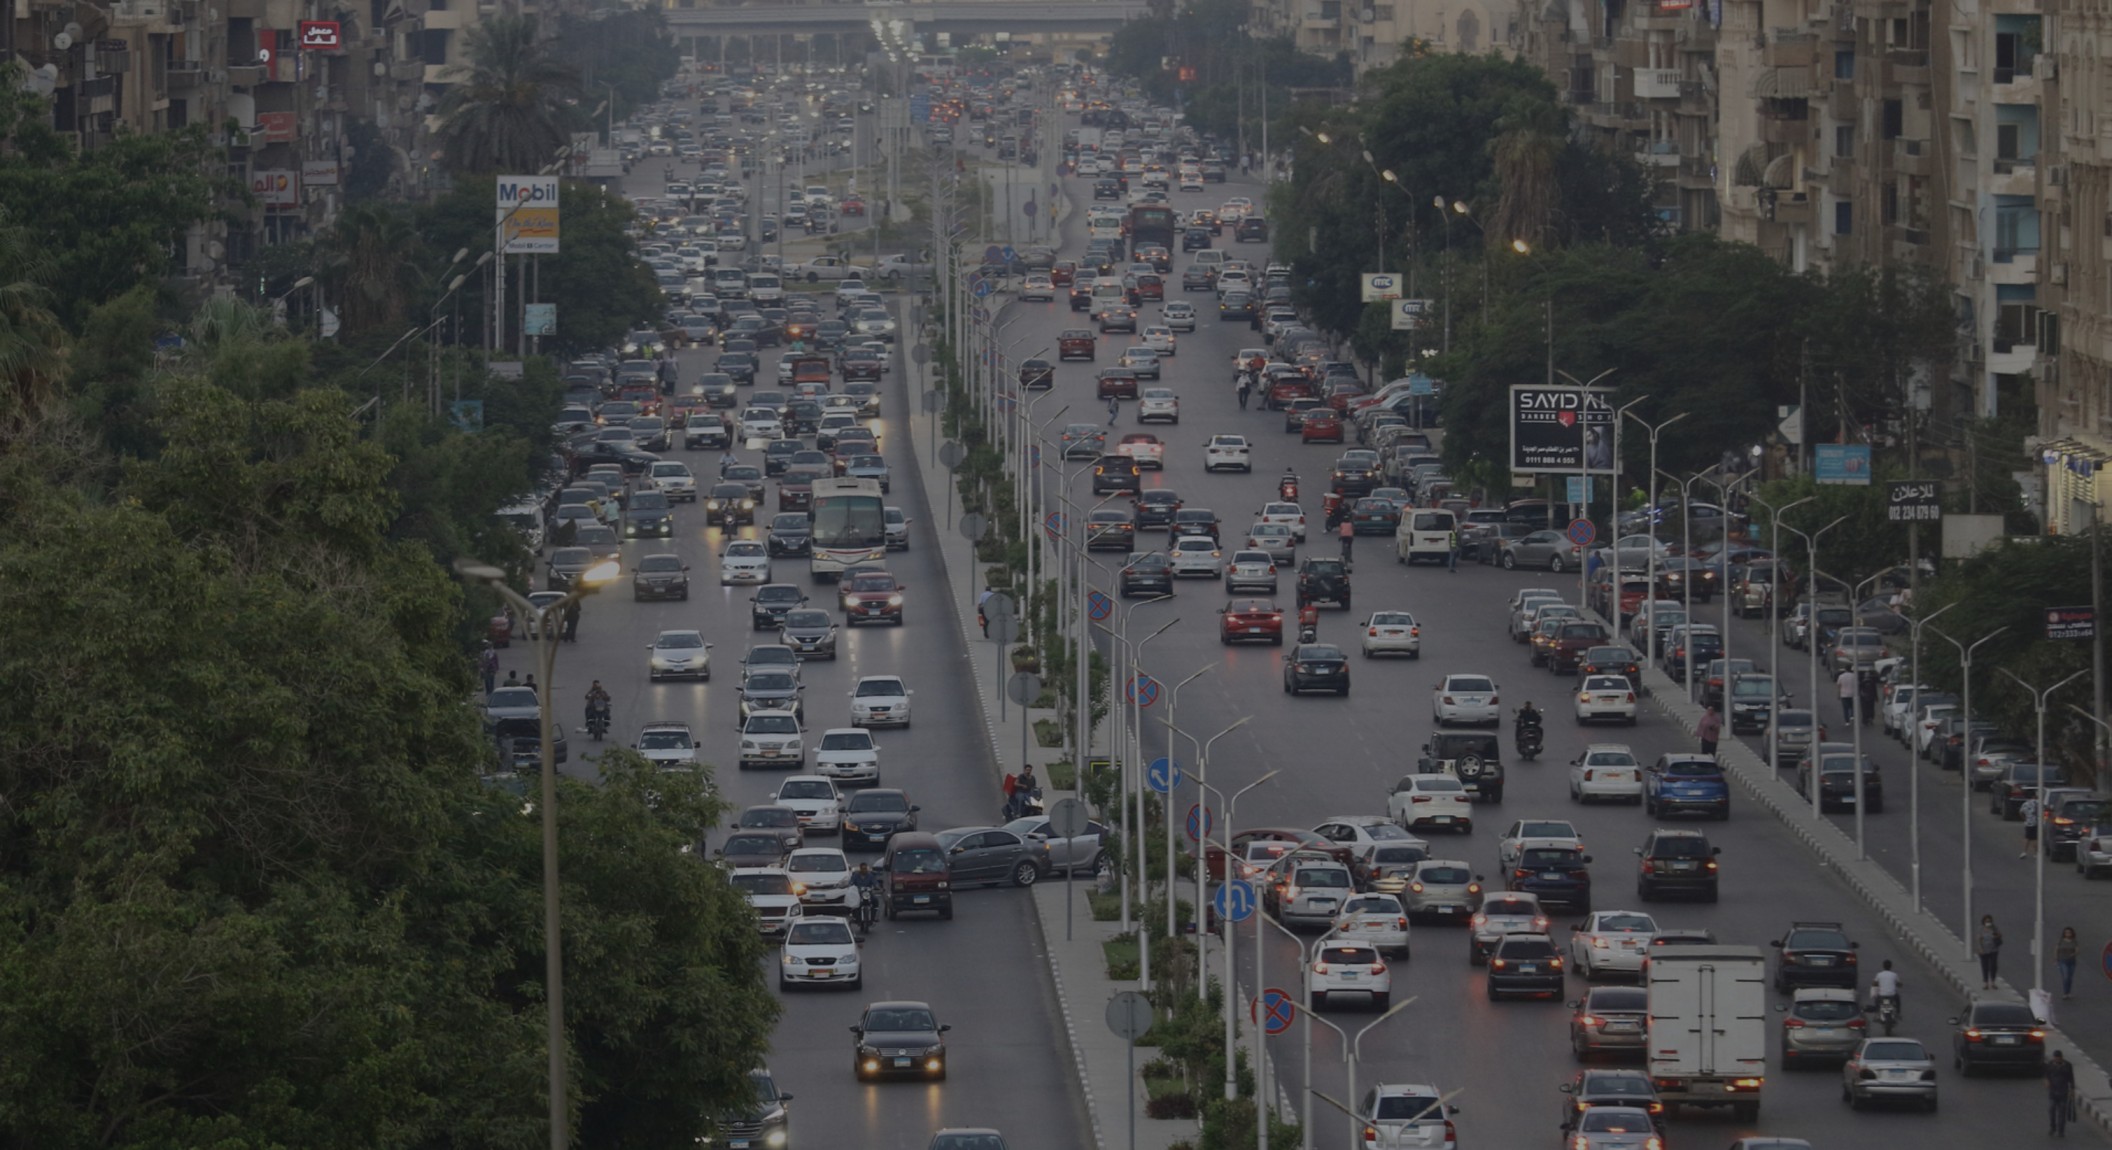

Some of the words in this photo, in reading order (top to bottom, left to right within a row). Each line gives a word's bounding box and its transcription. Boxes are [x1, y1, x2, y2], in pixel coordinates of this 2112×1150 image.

[500, 183, 556, 201] Mobil
[1520, 393, 1578, 409] SAYID
[1525, 456, 1541, 464] 0111
[1891, 484, 1934, 503] للإعلان
[1889, 505, 1901, 520] 012
[1902, 505, 1915, 520] 234
